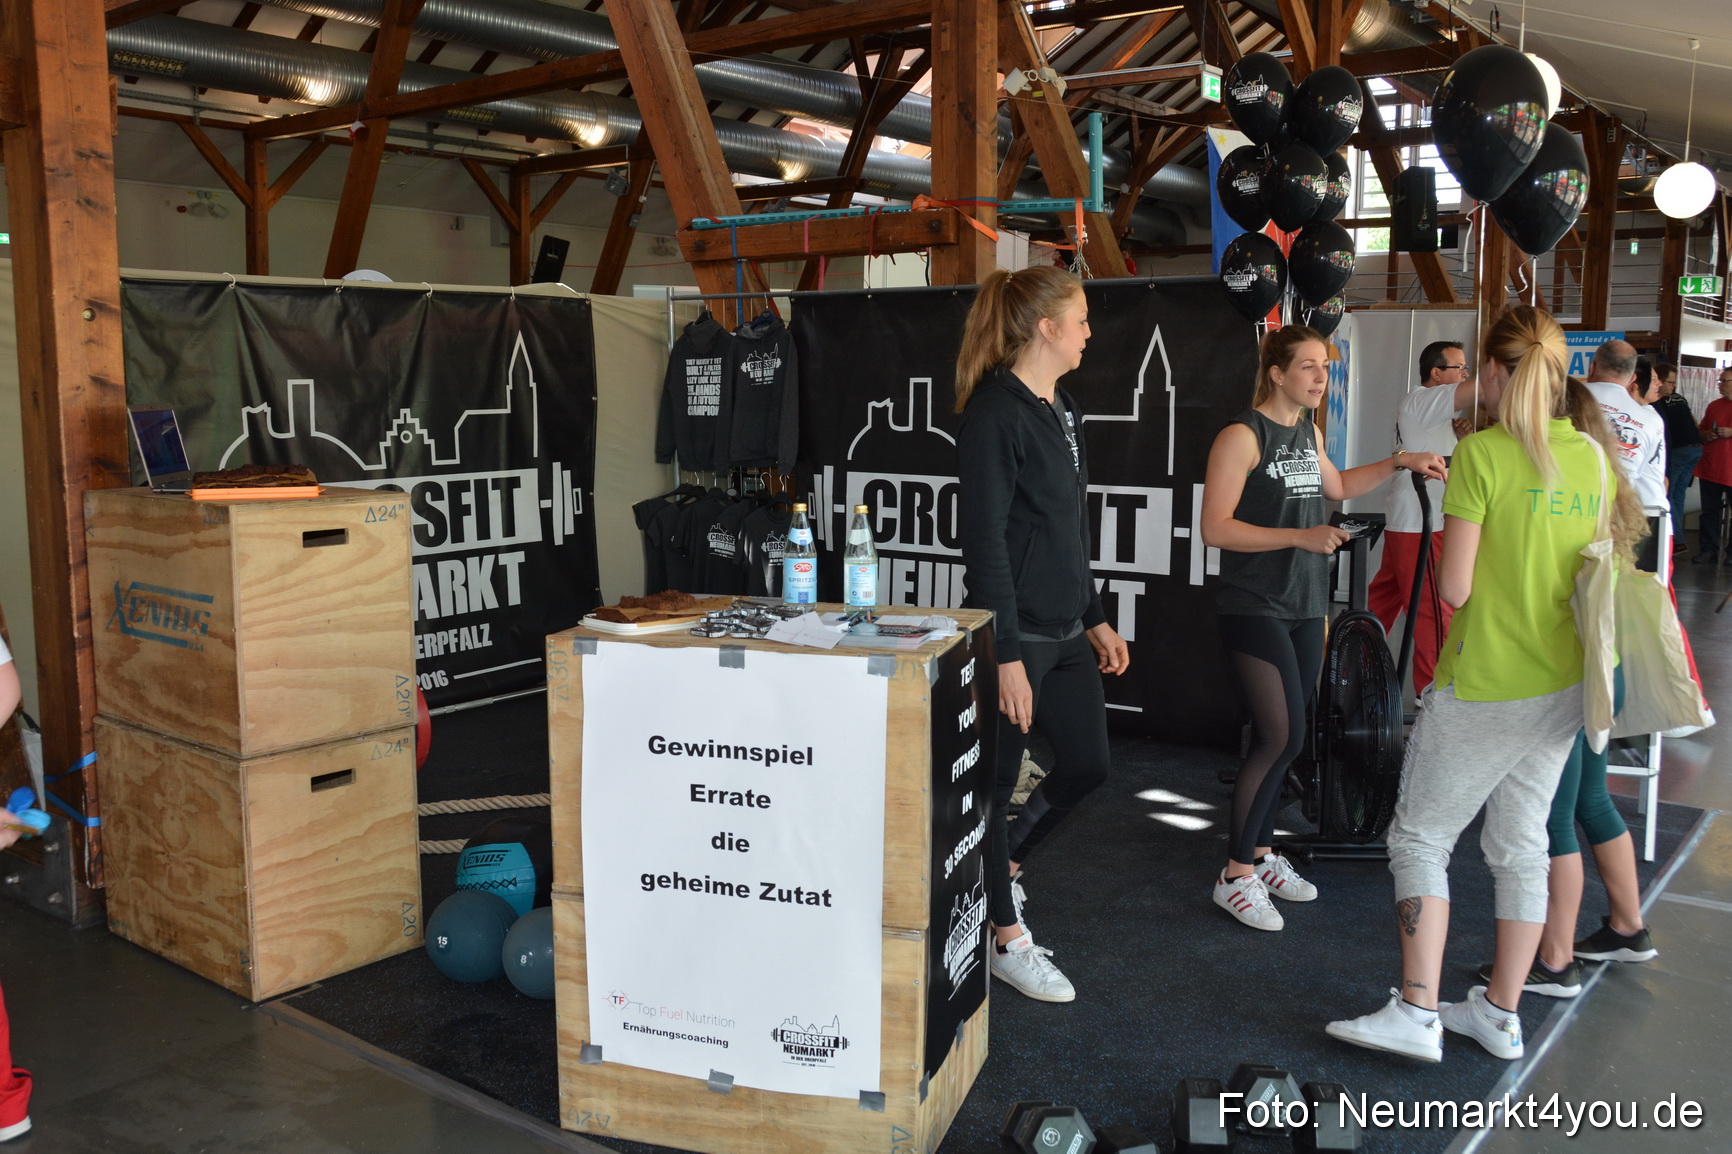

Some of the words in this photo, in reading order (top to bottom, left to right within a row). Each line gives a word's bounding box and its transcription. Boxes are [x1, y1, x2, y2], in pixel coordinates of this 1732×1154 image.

[1584, 335, 1602, 343] Bund
[1281, 460, 1318, 474] CROSSFIT
[1526, 488, 1601, 518] TEAM
[960, 657, 976, 688] TEST
[958, 700, 977, 733] YOUR
[648, 734, 813, 767] Gewinnspiel
[951, 739, 980, 783] FITNESS
[690, 783, 772, 809] Errate
[962, 791, 973, 815] IN
[711, 831, 750, 853] die
[944, 853, 953, 880] 30
[954, 815, 986, 866] SECONDS
[640, 871, 750, 899] geheime
[759, 881, 832, 907] Zutat
[437, 935, 448, 946] 15
[520, 954, 527, 964] 8
[612, 995, 625, 1006] TF
[637, 1003, 657, 1017] Top
[659, 1006, 683, 1021] Fuel
[686, 1010, 736, 1029] Nutrition
[623, 1021, 729, 1049] Ernährungscoaching
[783, 1030, 836, 1047] CROSSFIT
[783, 1043, 836, 1058] NEUMARKT
